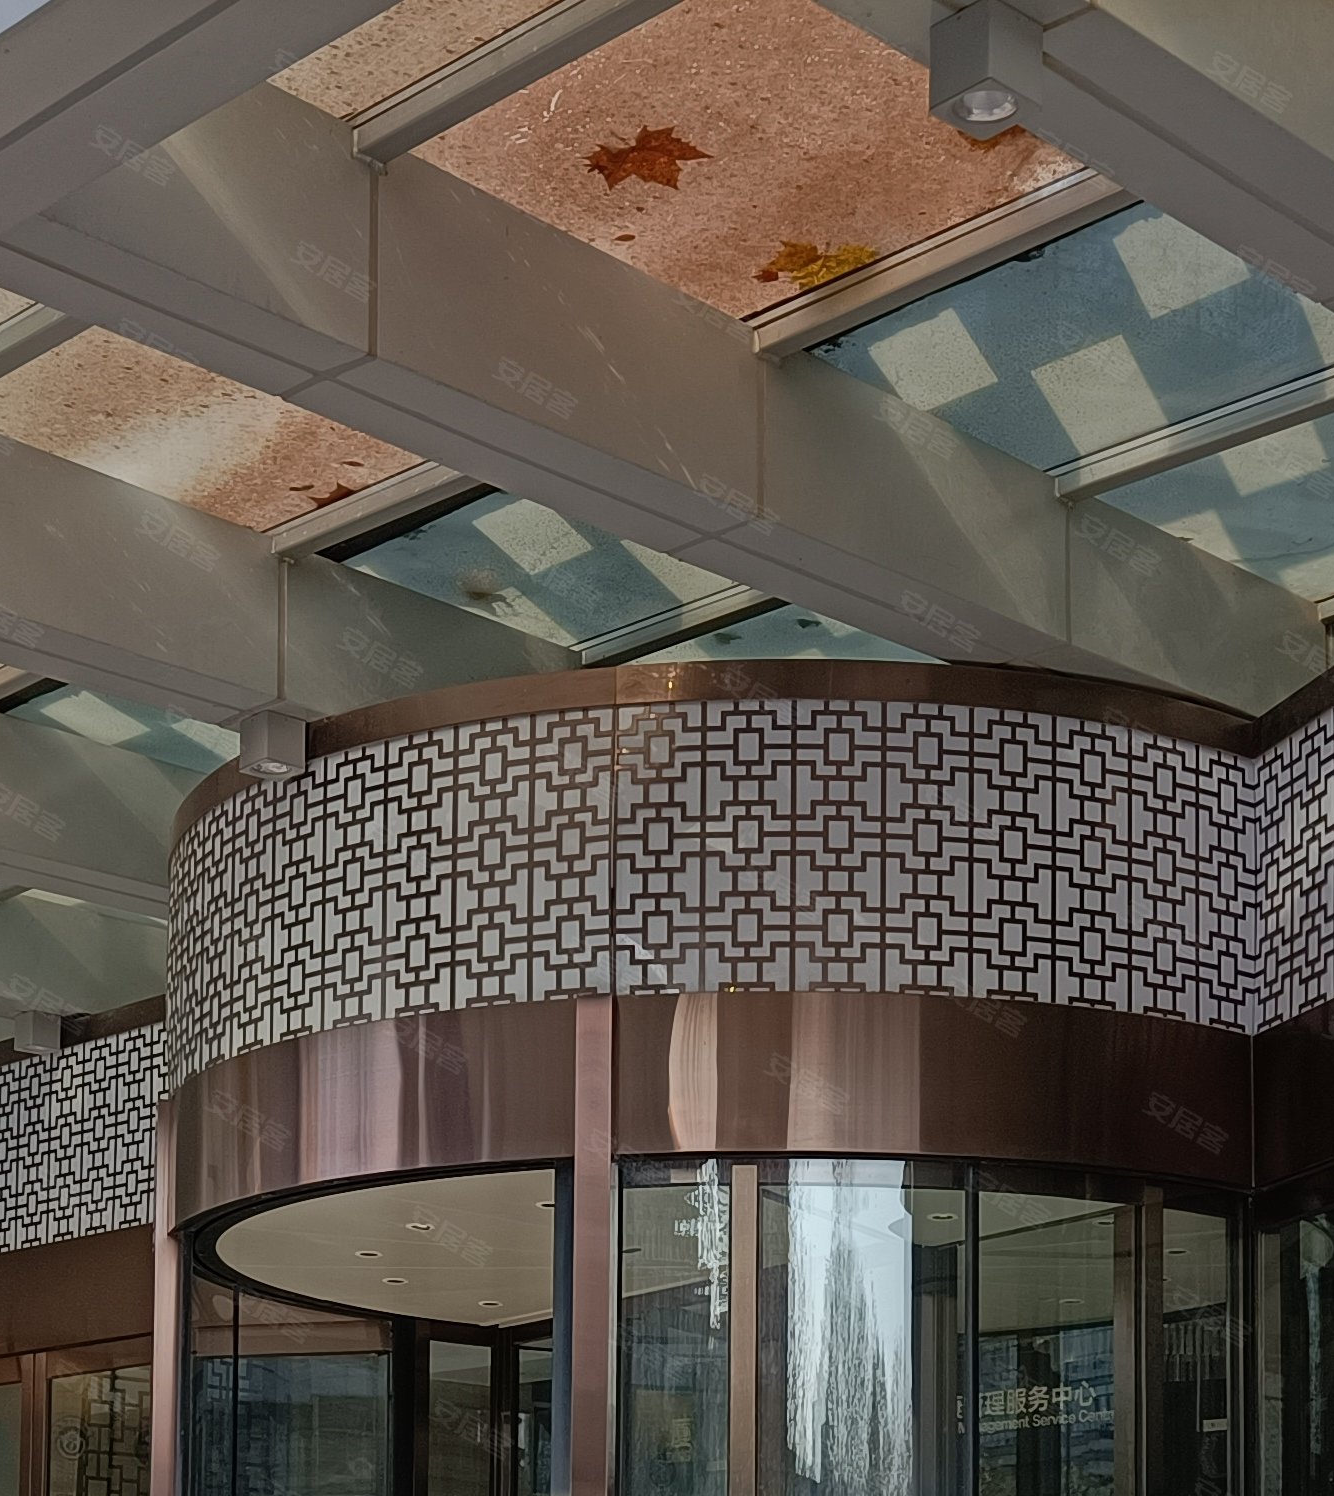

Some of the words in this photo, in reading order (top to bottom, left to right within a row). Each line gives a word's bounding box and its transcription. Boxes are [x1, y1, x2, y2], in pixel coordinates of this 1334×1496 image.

[978, 1381, 1097, 1417] 理服务中心
[1032, 1413, 1076, 1428] Service
